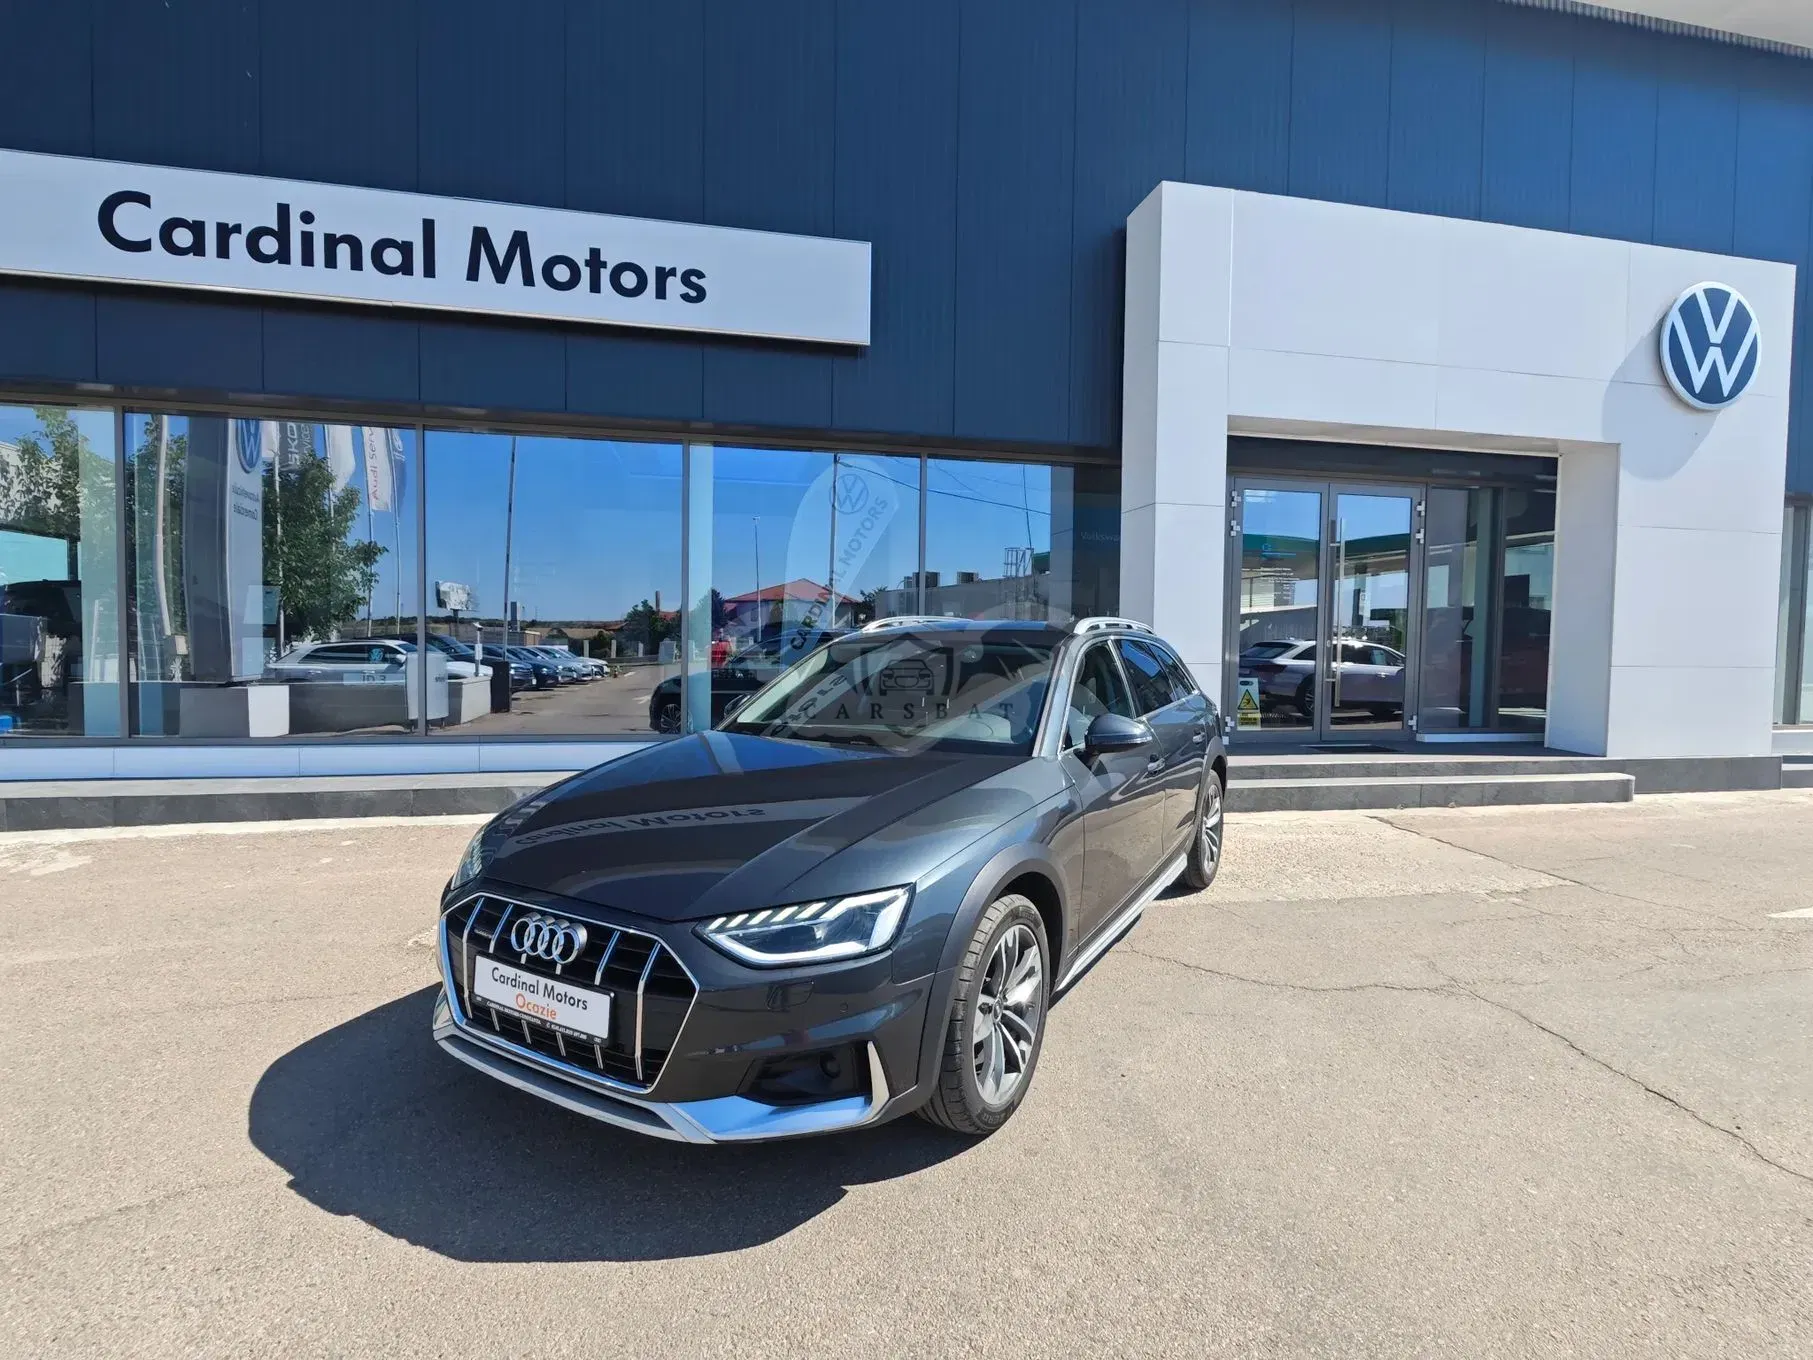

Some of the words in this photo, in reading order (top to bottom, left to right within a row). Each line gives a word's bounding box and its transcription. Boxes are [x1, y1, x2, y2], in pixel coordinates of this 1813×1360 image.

[96, 189, 438, 279] Cardinal
[465, 226, 709, 305] Motors
[1659, 281, 1763, 411] VW
[843, 495, 889, 567] MOTORS
[491, 966, 540, 995] Cardinal
[543, 983, 588, 1010] Motors
[515, 992, 557, 1019] Ocazie
